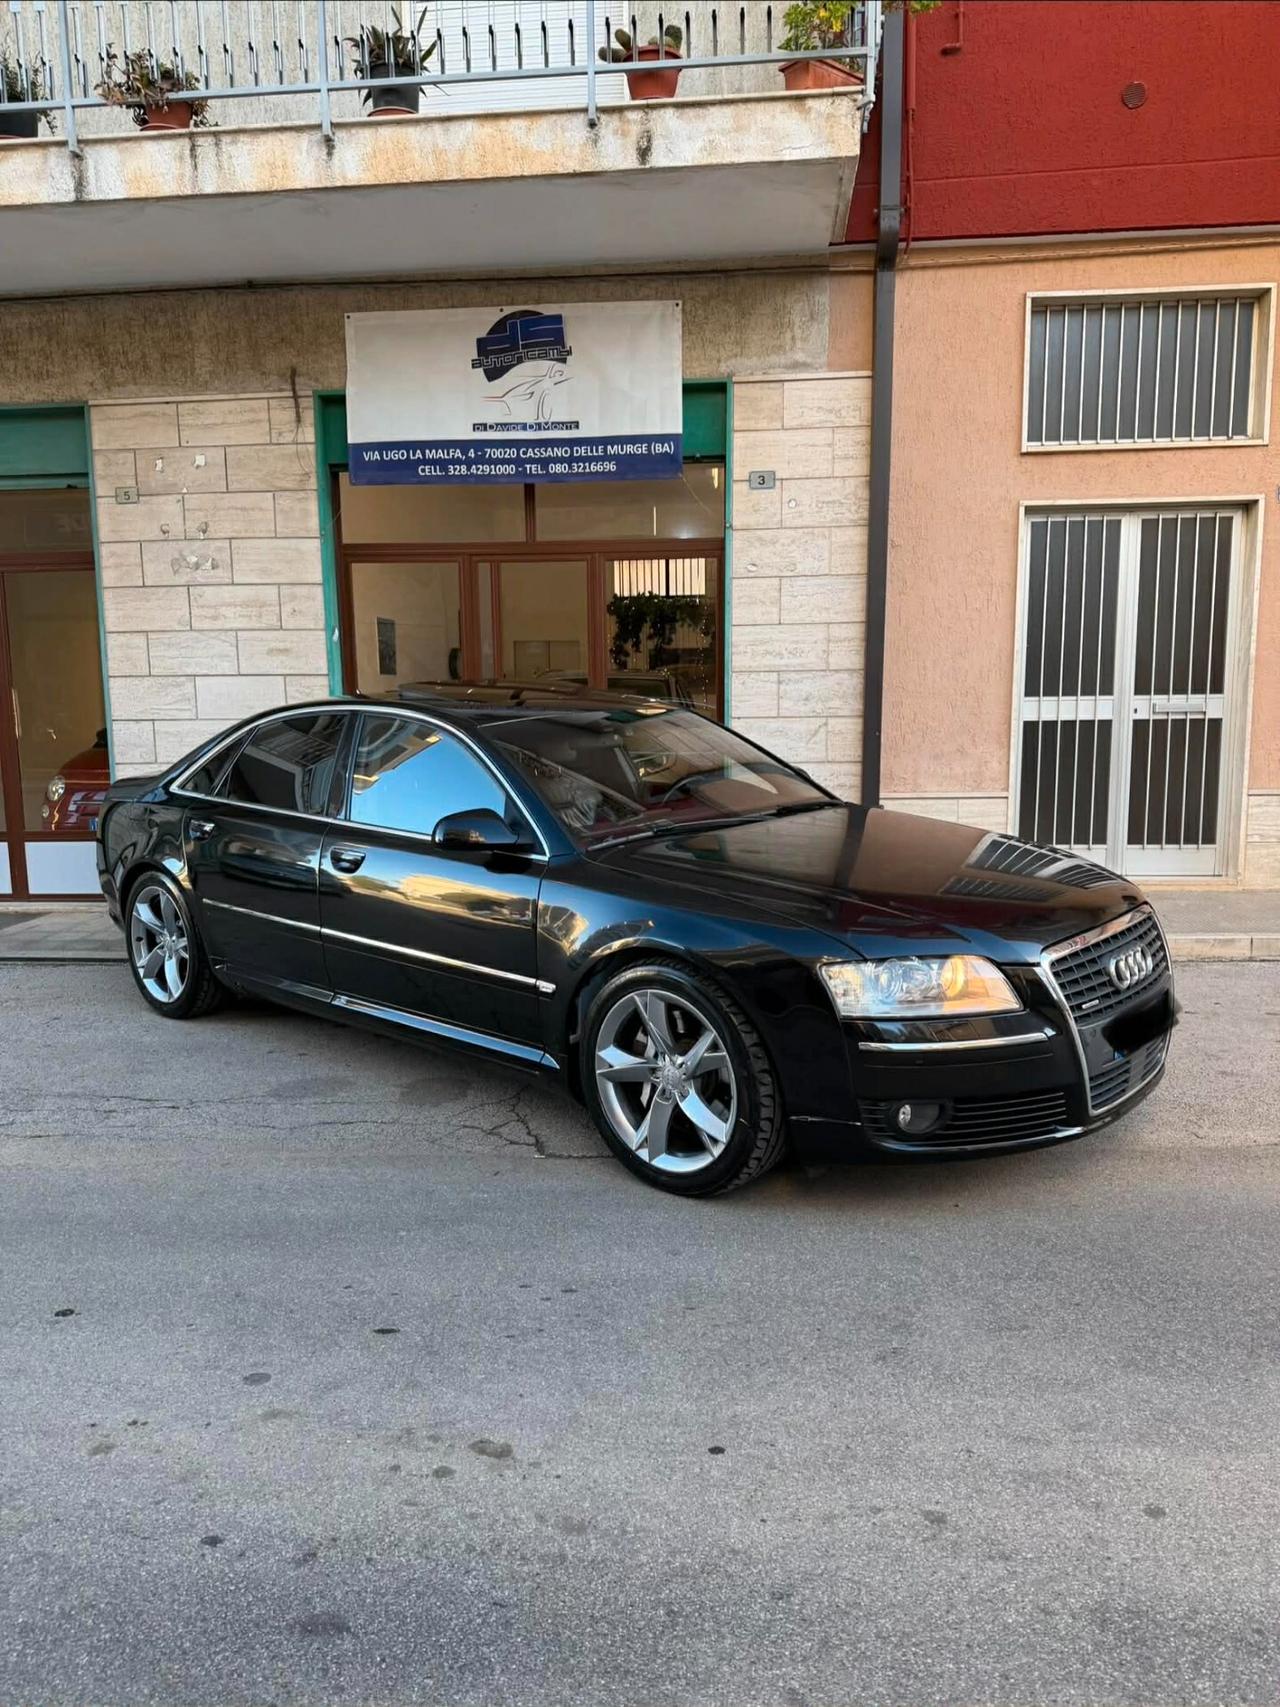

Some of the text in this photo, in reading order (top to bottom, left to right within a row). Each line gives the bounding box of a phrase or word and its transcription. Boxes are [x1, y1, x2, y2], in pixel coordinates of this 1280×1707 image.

[363, 451, 380, 461] VIA
[383, 449, 407, 460] UGO
[410, 449, 423, 459] LA
[425, 448, 466, 460] MALFA,
[468, 448, 475, 458] 4
[484, 448, 517, 459] 70020
[519, 446, 571, 458] CASSANO
[573, 445, 604, 456] DELLE
[607, 443, 648, 455] MURGE
[651, 441, 674, 455] (BA)
[418, 465, 446, 475] CELL.
[447, 463, 516, 475] 328.4291000
[525, 463, 546, 474] TEL.
[548, 461, 617, 474] 080.3216696
[758, 475, 766, 486] 3
[124, 491, 131, 501] 5
